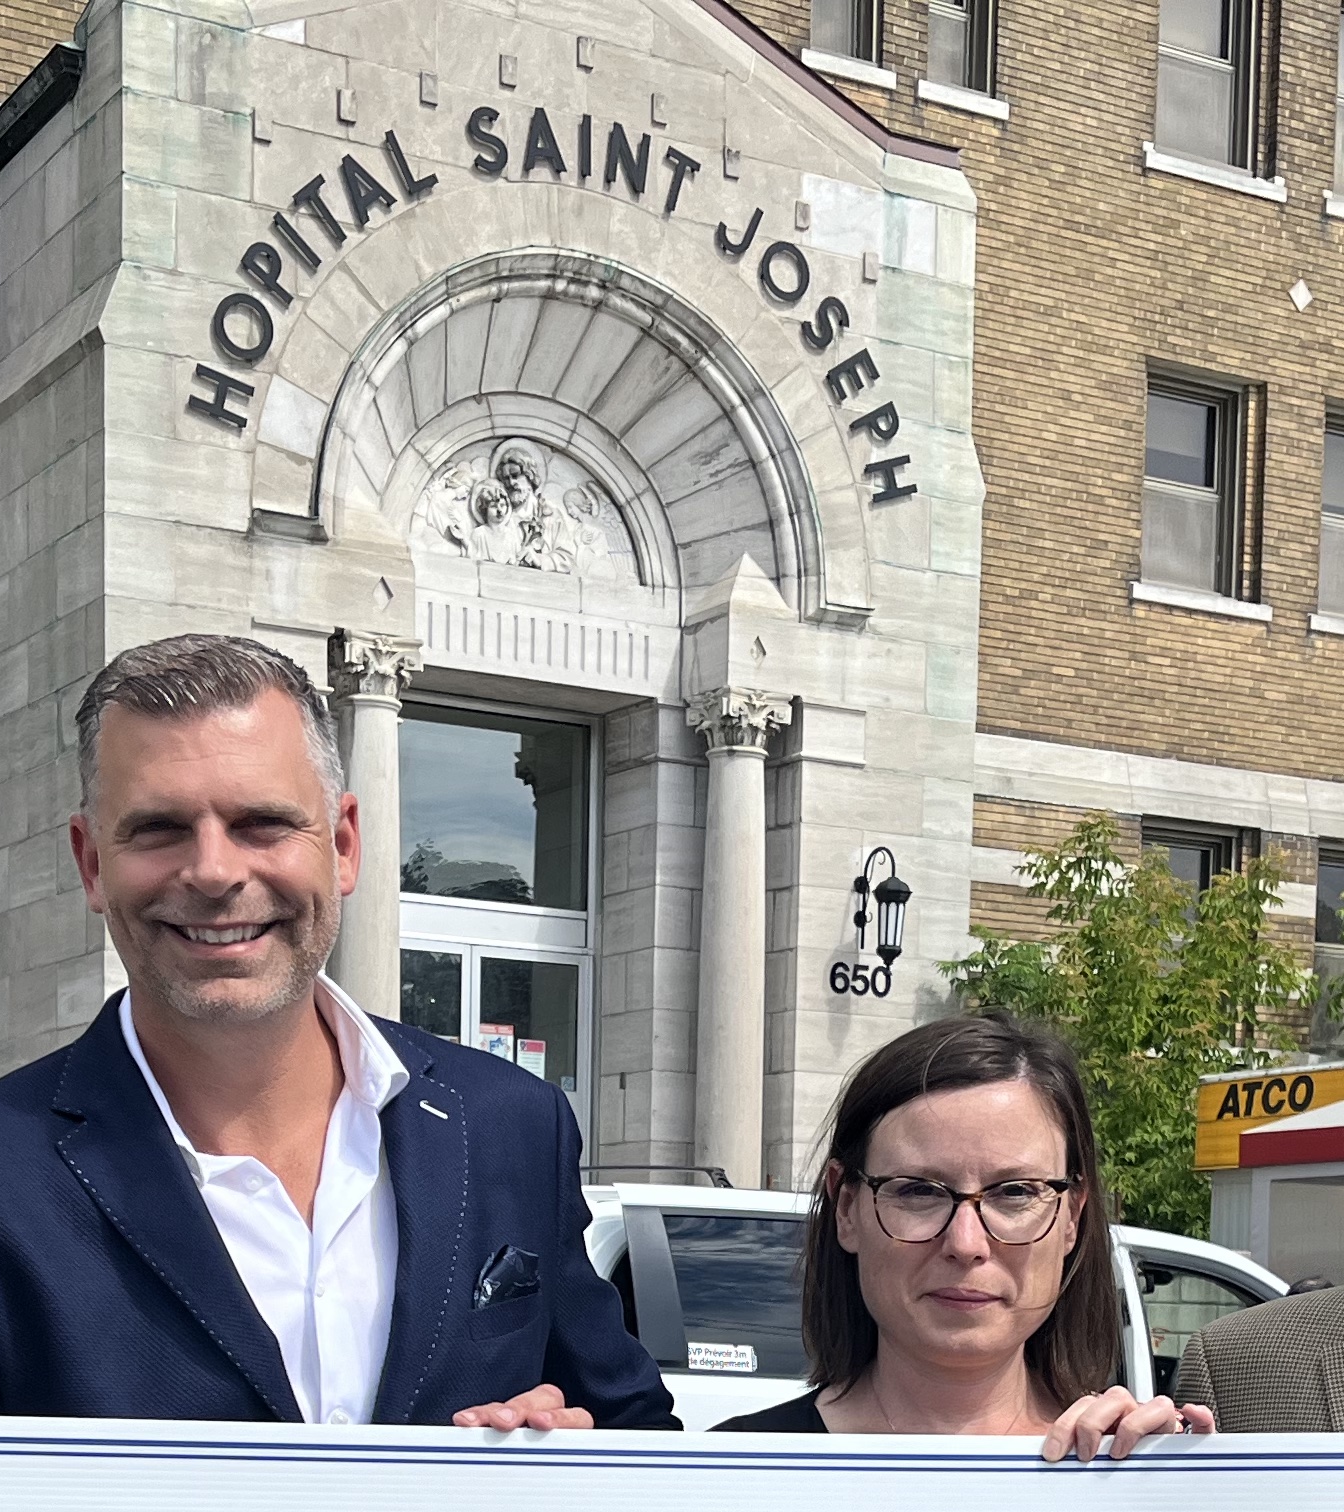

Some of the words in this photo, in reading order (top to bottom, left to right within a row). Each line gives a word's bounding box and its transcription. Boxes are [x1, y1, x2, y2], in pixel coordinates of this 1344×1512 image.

[185, 129, 439, 430] HOPITAL
[466, 105, 701, 216] SAINT
[716, 206, 918, 506] JOSEPH
[830, 962, 891, 998] 650
[1217, 1075, 1315, 1120] ATCO
